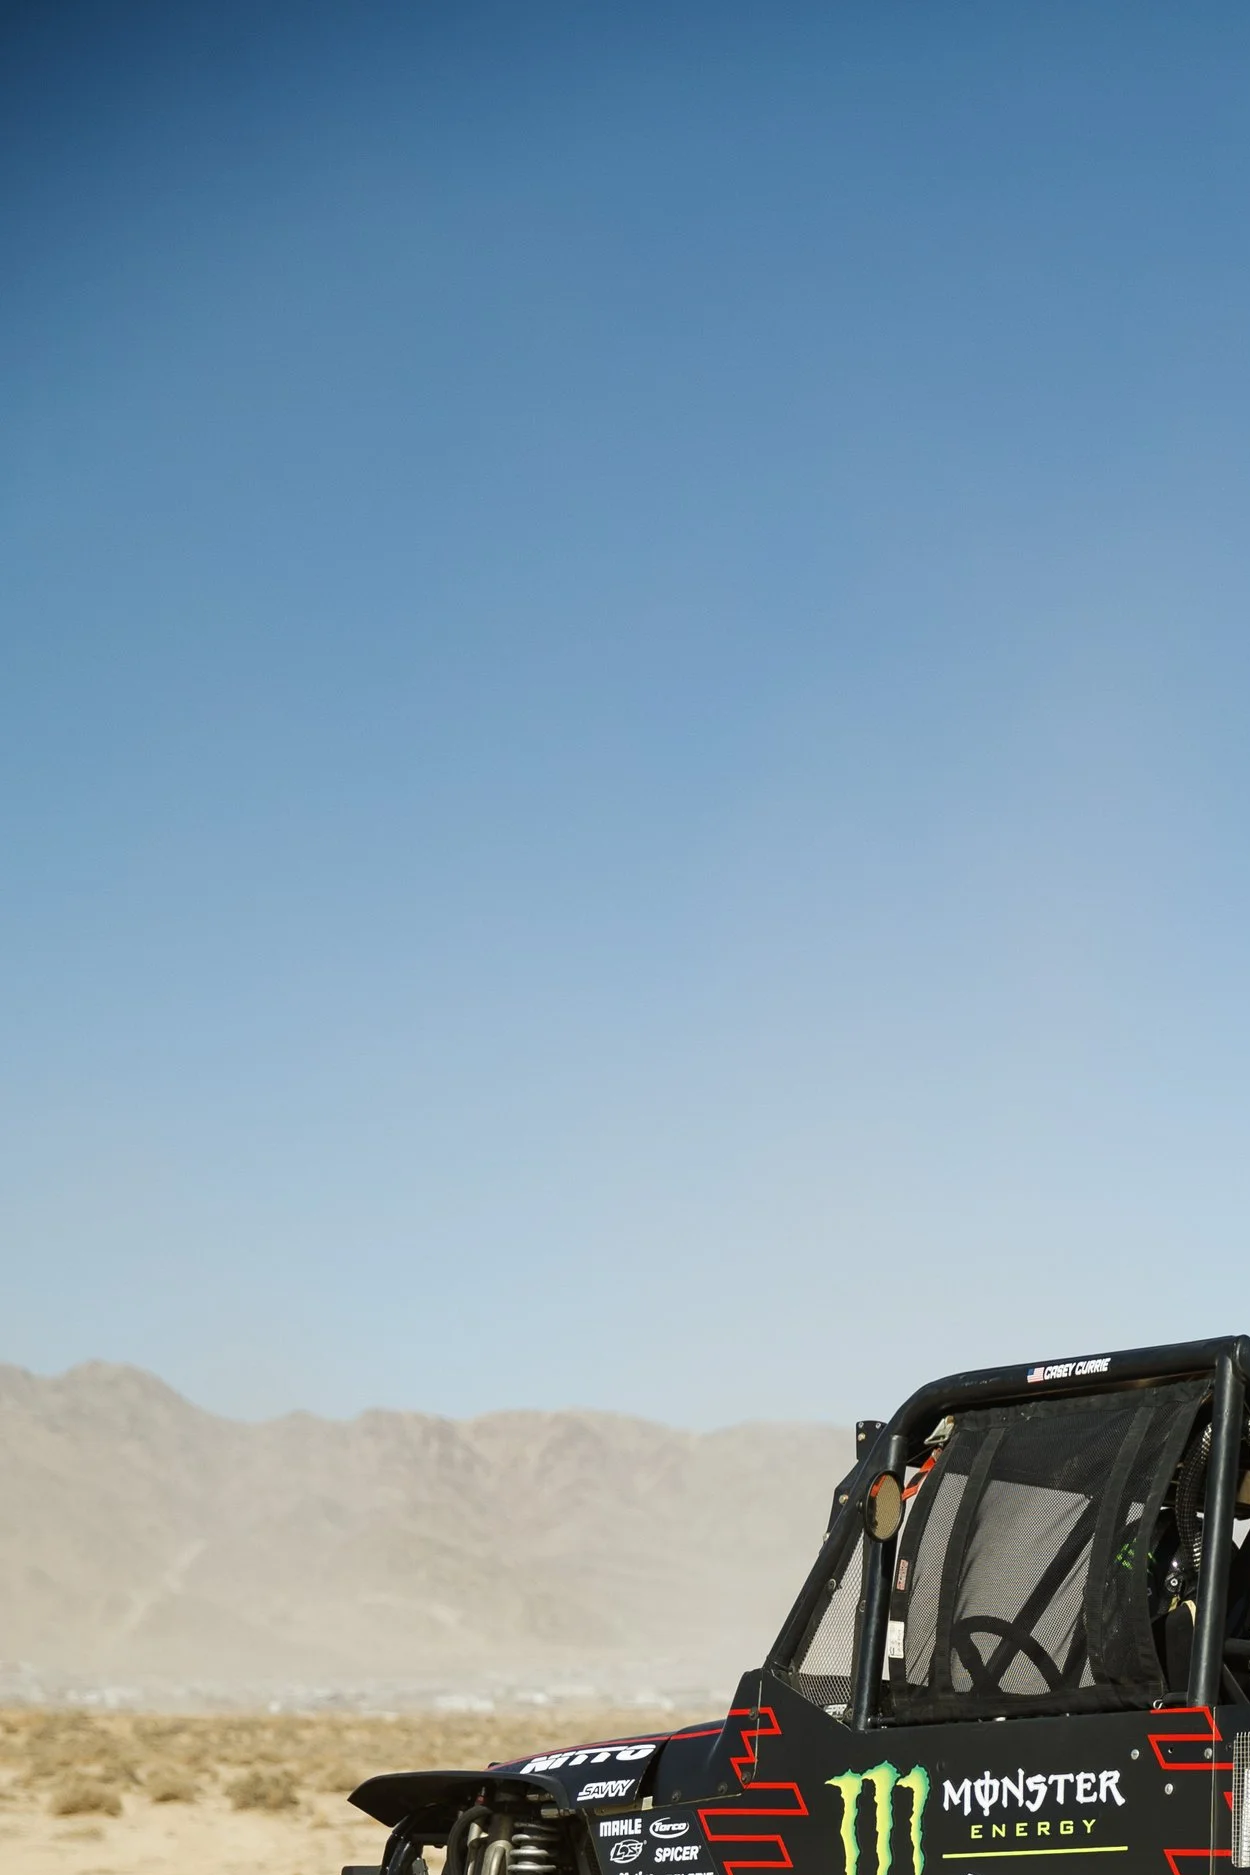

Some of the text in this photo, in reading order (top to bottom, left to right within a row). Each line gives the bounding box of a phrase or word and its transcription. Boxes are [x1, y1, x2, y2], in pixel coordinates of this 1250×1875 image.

[1044, 1358, 1111, 1380] CASEY CURRIE
[520, 1744, 656, 1774] NITTO
[577, 1779, 635, 1801] SAVVY
[600, 1818, 642, 1837] MAHLE
[654, 1823, 687, 1832] Torco
[971, 1819, 1096, 1839] ENERGY
[654, 1846, 699, 1862] SPICER
